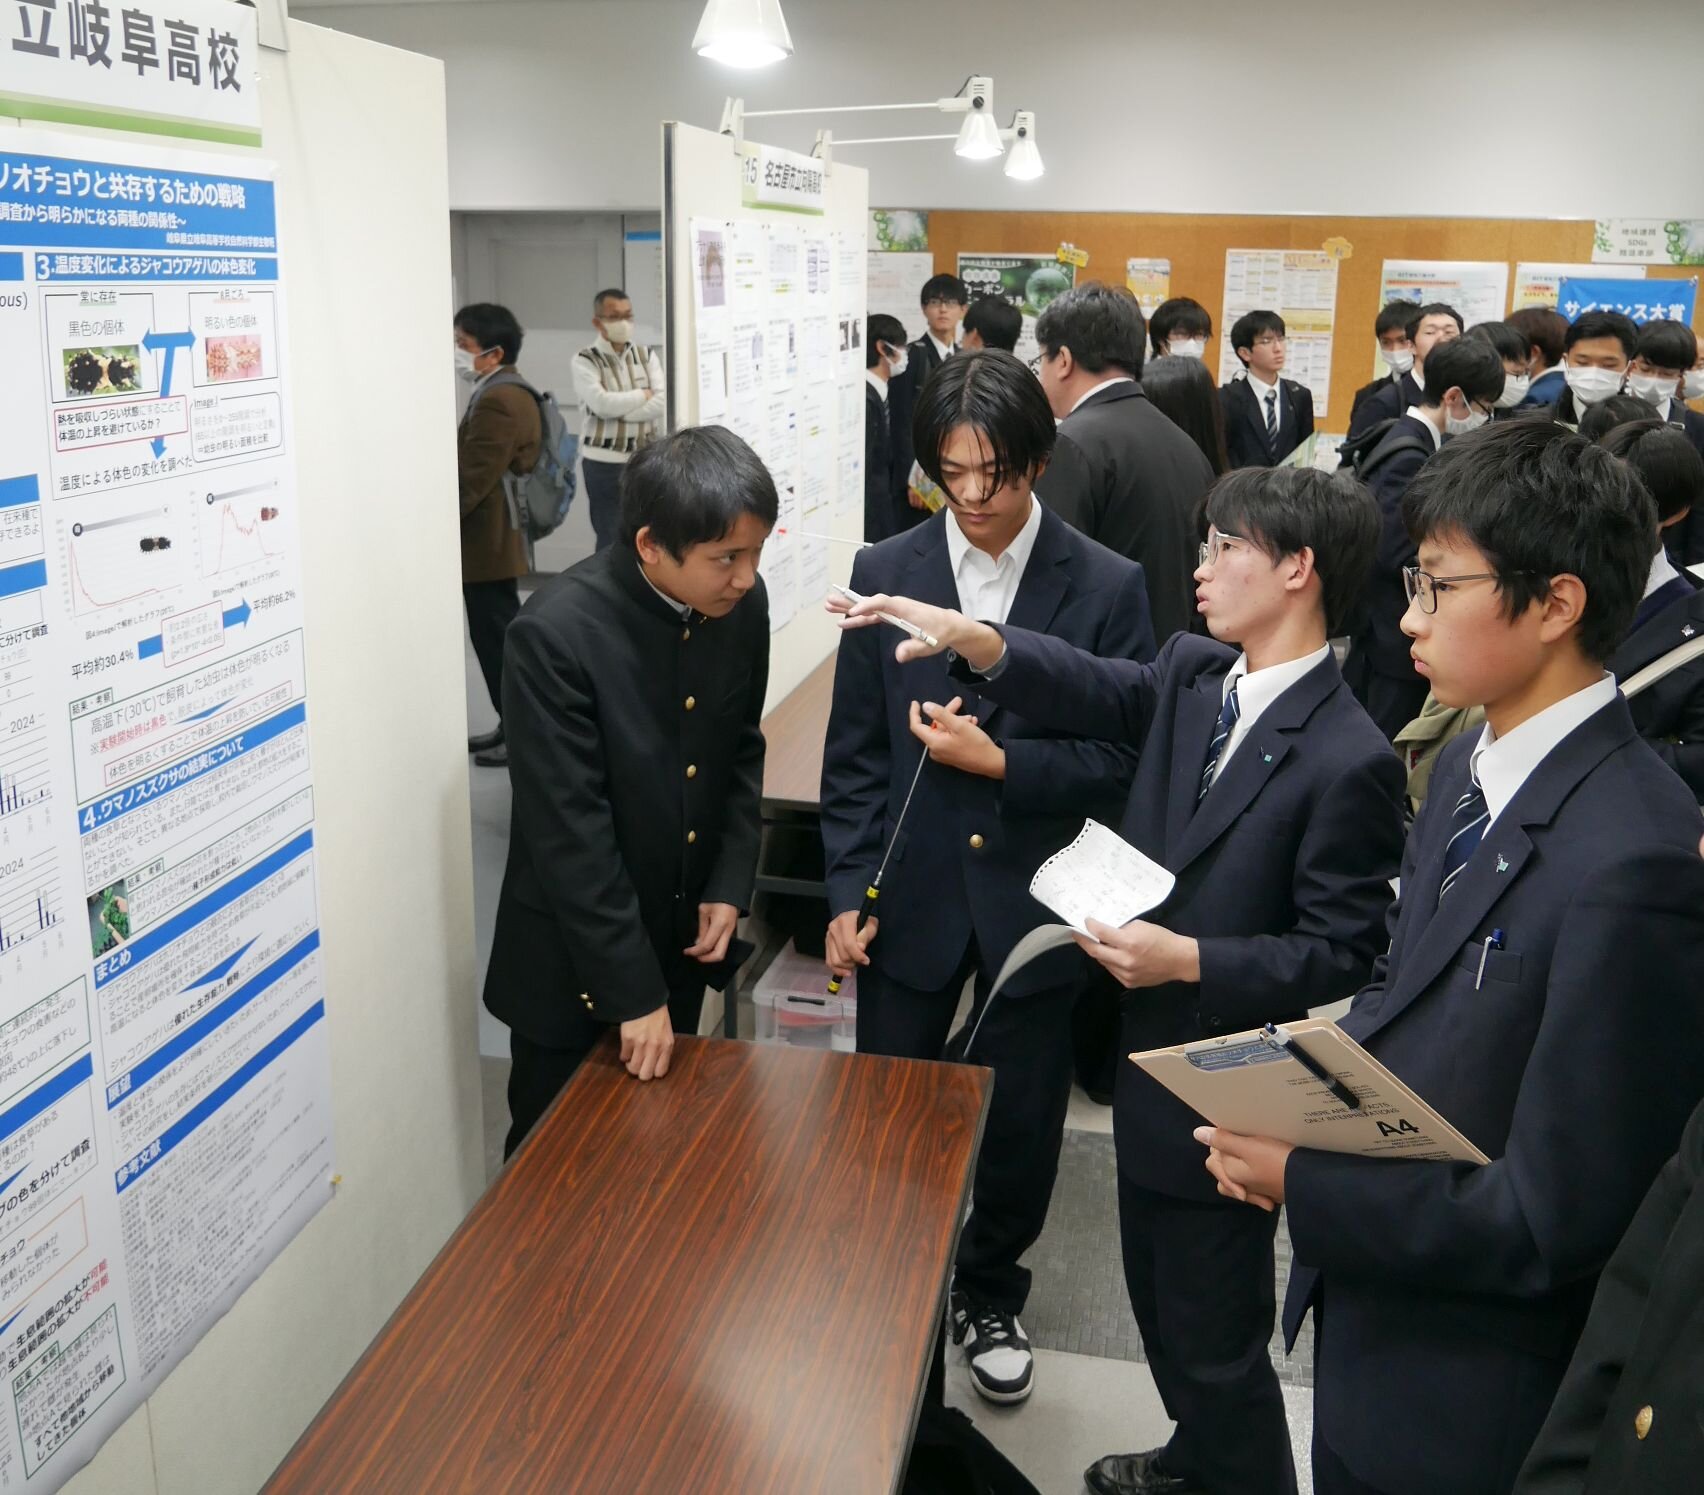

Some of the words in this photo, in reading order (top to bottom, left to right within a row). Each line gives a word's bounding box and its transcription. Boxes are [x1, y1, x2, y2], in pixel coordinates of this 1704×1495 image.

[12, 0, 241, 93] 立岐阜高校
[745, 157, 758, 184] 15
[37, 254, 256, 280] 3.温度変化によるジャコウアゲハの体色変化
[80, 290, 117, 304] 常に存在
[69, 320, 125, 337] 黒色の個体
[205, 315, 257, 330] 明るい色の個体
[60, 456, 193, 491] 温度による体色の変化を調べた
[253, 590, 296, 613] 平均約66.2%
[72, 648, 135, 680] 平均約30.4%
[10, 715, 36, 734] 2024
[83, 736, 244, 828] 4.ウマノスズクサの結実について
[0, 859, 24, 879] 2024
[96, 949, 132, 981] まとめ
[108, 1073, 132, 1103] 展望
[1363, 1102, 1393, 1111] ACTS,
[1376, 1118, 1420, 1137] A4
[116, 1139, 163, 1187] 参考文献
